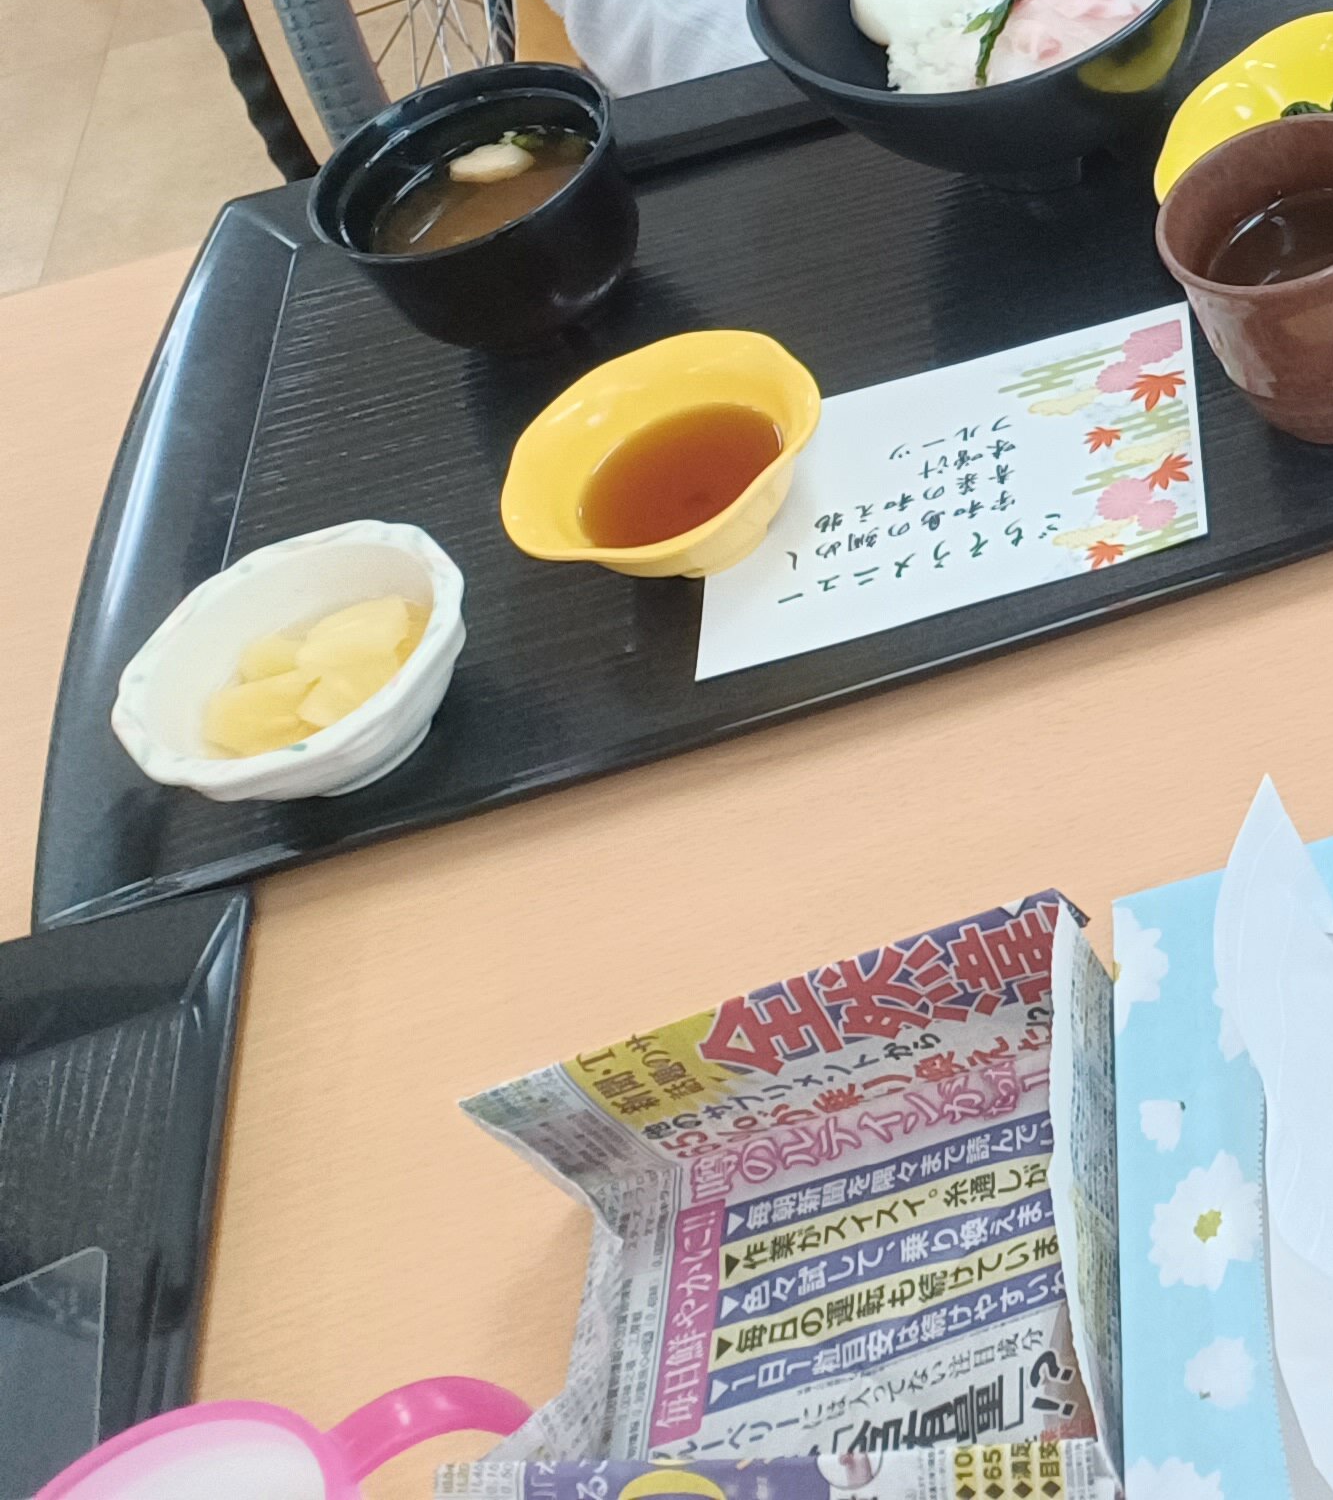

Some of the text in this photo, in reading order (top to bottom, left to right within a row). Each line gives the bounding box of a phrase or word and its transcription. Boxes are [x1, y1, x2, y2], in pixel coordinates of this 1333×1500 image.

[889, 415, 1012, 460] フルーツ
[917, 439, 1016, 479] 味噌汁
[786, 490, 1016, 571] 宇和島の鯛めし
[815, 464, 1015, 533] 青菜の和え物
[778, 513, 1061, 603] ごちそうメニュー
[741, 1201, 1054, 1312] 色々試して、乗り換えま
[955, 1444, 975, 1481] 10
